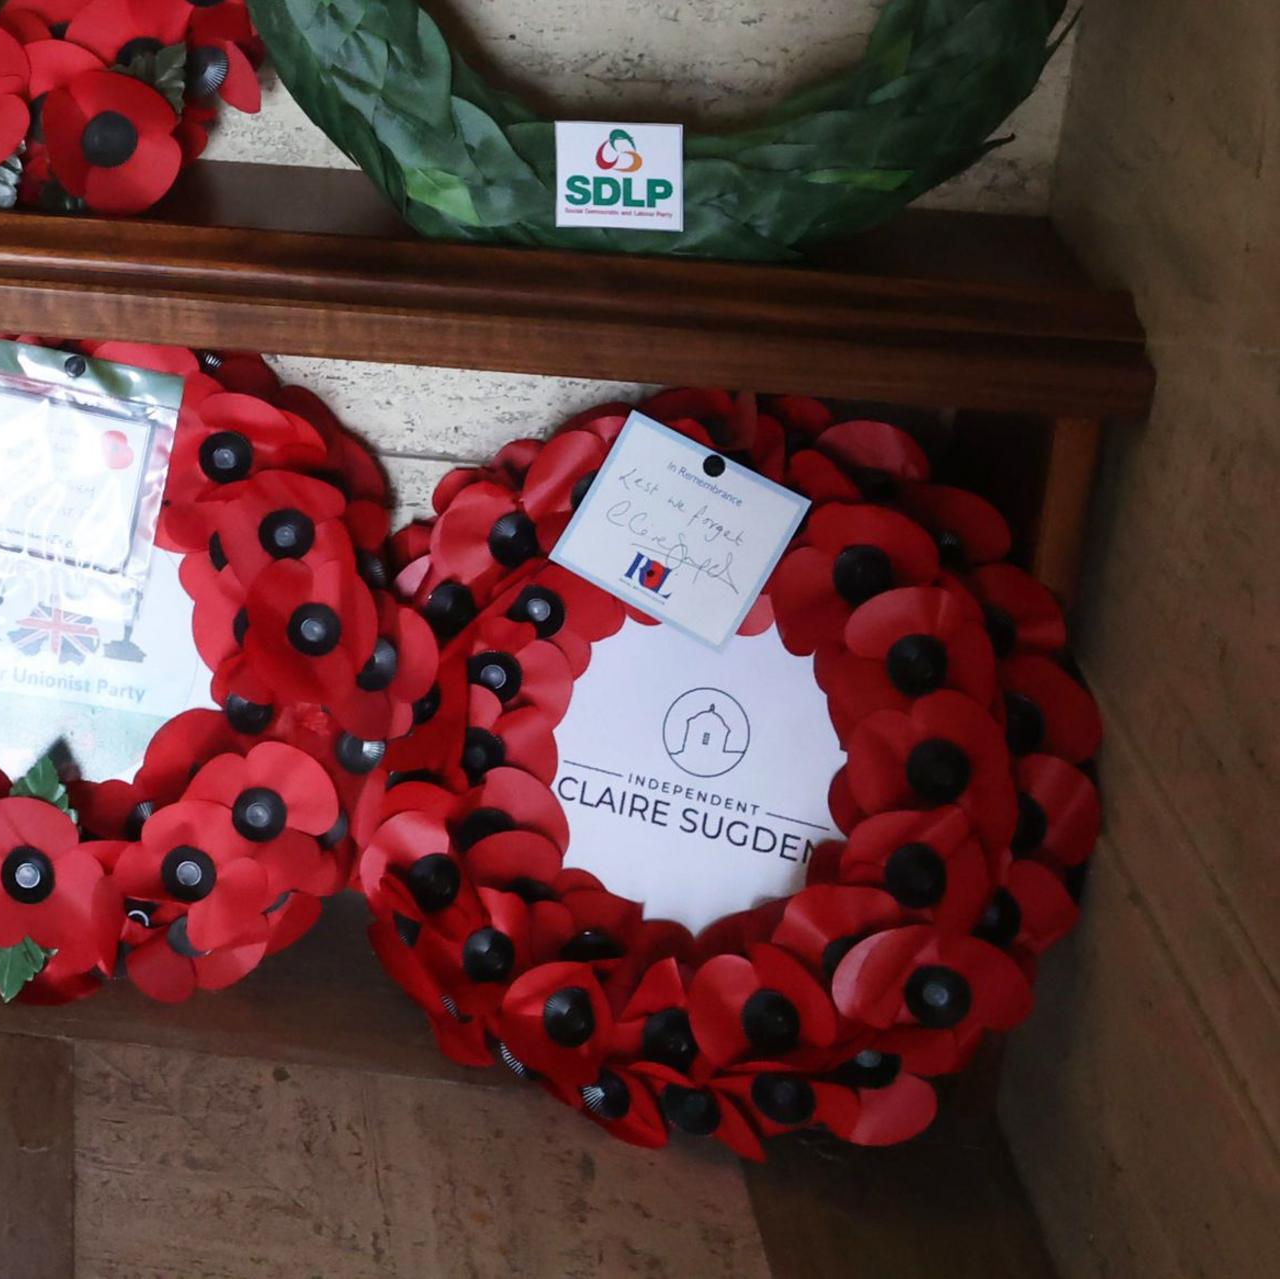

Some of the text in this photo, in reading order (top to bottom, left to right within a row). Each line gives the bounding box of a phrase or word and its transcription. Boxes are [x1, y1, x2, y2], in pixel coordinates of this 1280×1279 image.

[564, 174, 674, 209] SDLP
[666, 461, 743, 508] In Remembrance
[687, 505, 744, 546] forget
[13, 662, 91, 694] Unionist
[96, 678, 148, 703] Party
[557, 776, 671, 827] CLAIRE
[627, 772, 761, 816] INDEPENDENT
